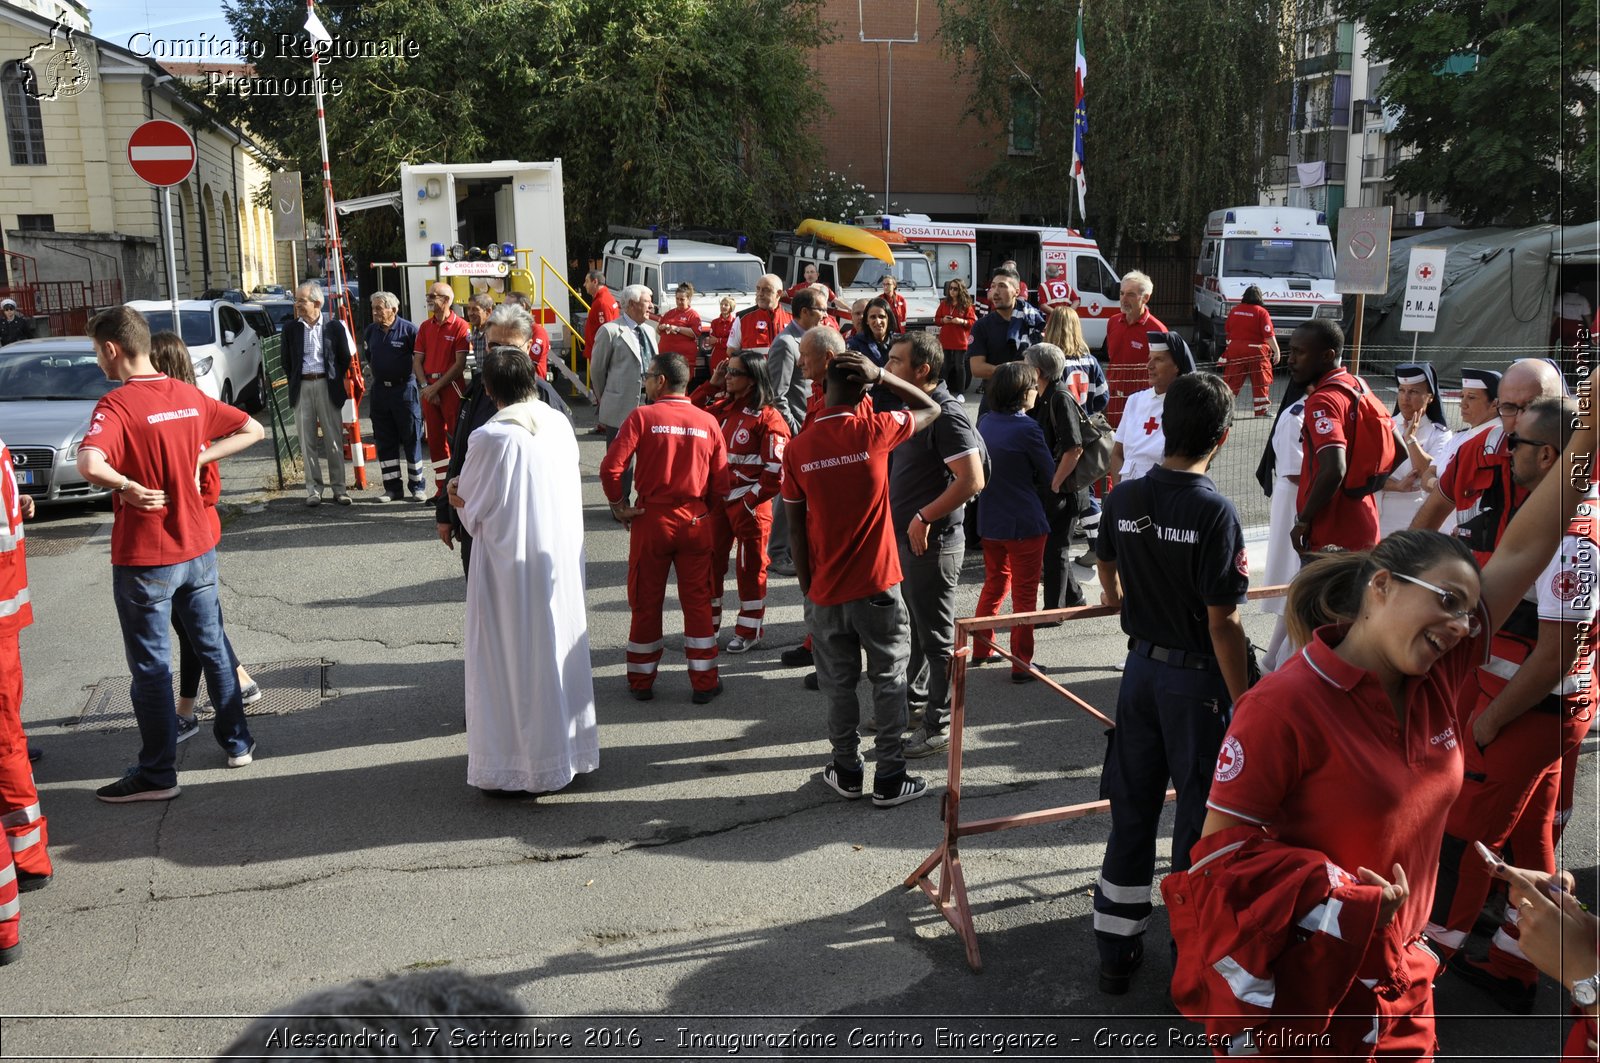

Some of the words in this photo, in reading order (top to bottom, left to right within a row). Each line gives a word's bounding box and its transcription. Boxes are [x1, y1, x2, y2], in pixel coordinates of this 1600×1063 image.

[897, 226, 930, 236] ROSSA
[933, 228, 975, 237] ITALIANA
[1046, 252, 1066, 260] PCA
[1405, 300, 1412, 311] P.
[1415, 301, 1425, 311] M.
[1428, 301, 1436, 311] A.
[651, 425, 670, 434] CROCE
[800, 461, 821, 473] CROCE
[820, 457, 841, 469] ROSSA
[840, 451, 870, 465] ITALIANA
[1164, 527, 1199, 544] ITALIANA
[1430, 726, 1454, 745] CROCE
